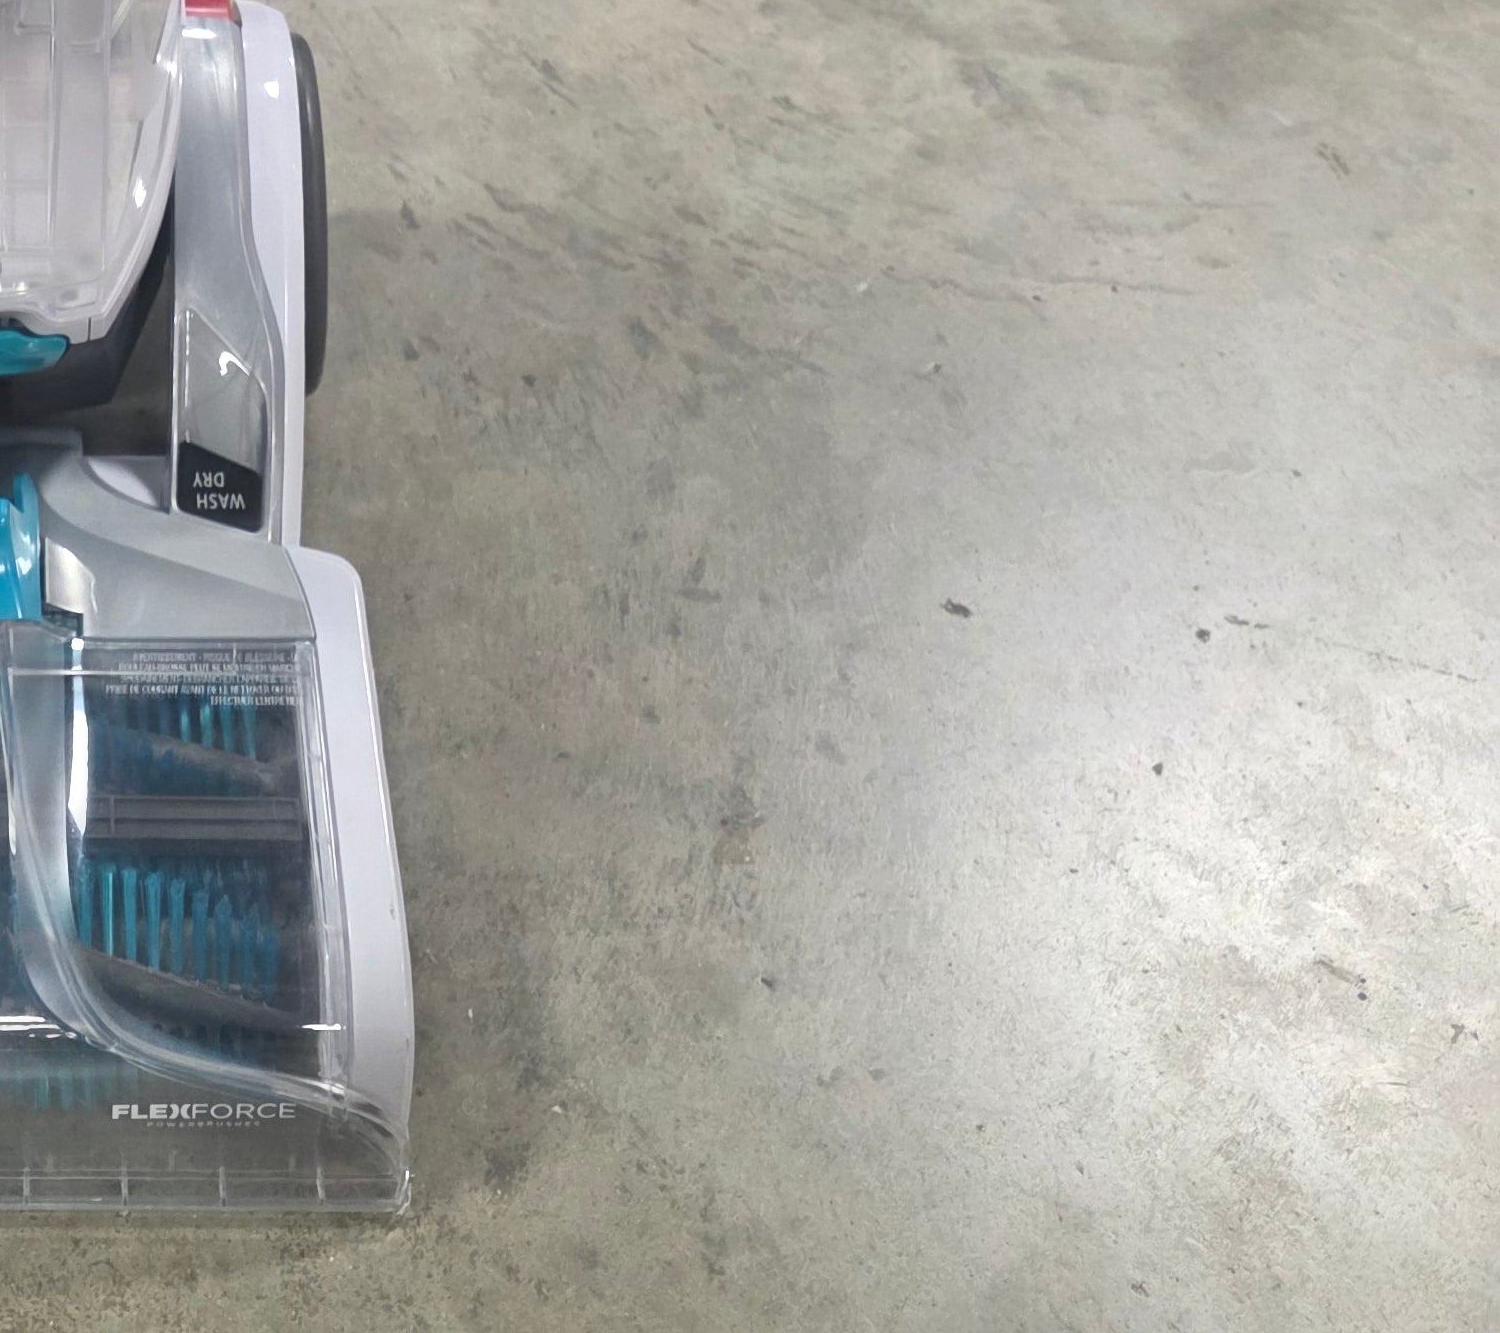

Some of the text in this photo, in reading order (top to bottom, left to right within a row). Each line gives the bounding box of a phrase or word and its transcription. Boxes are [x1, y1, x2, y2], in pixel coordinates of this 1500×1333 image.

[192, 471, 225, 488] DRY
[196, 493, 246, 510] WASH
[111, 1102, 297, 1121] FLEXFORCE
